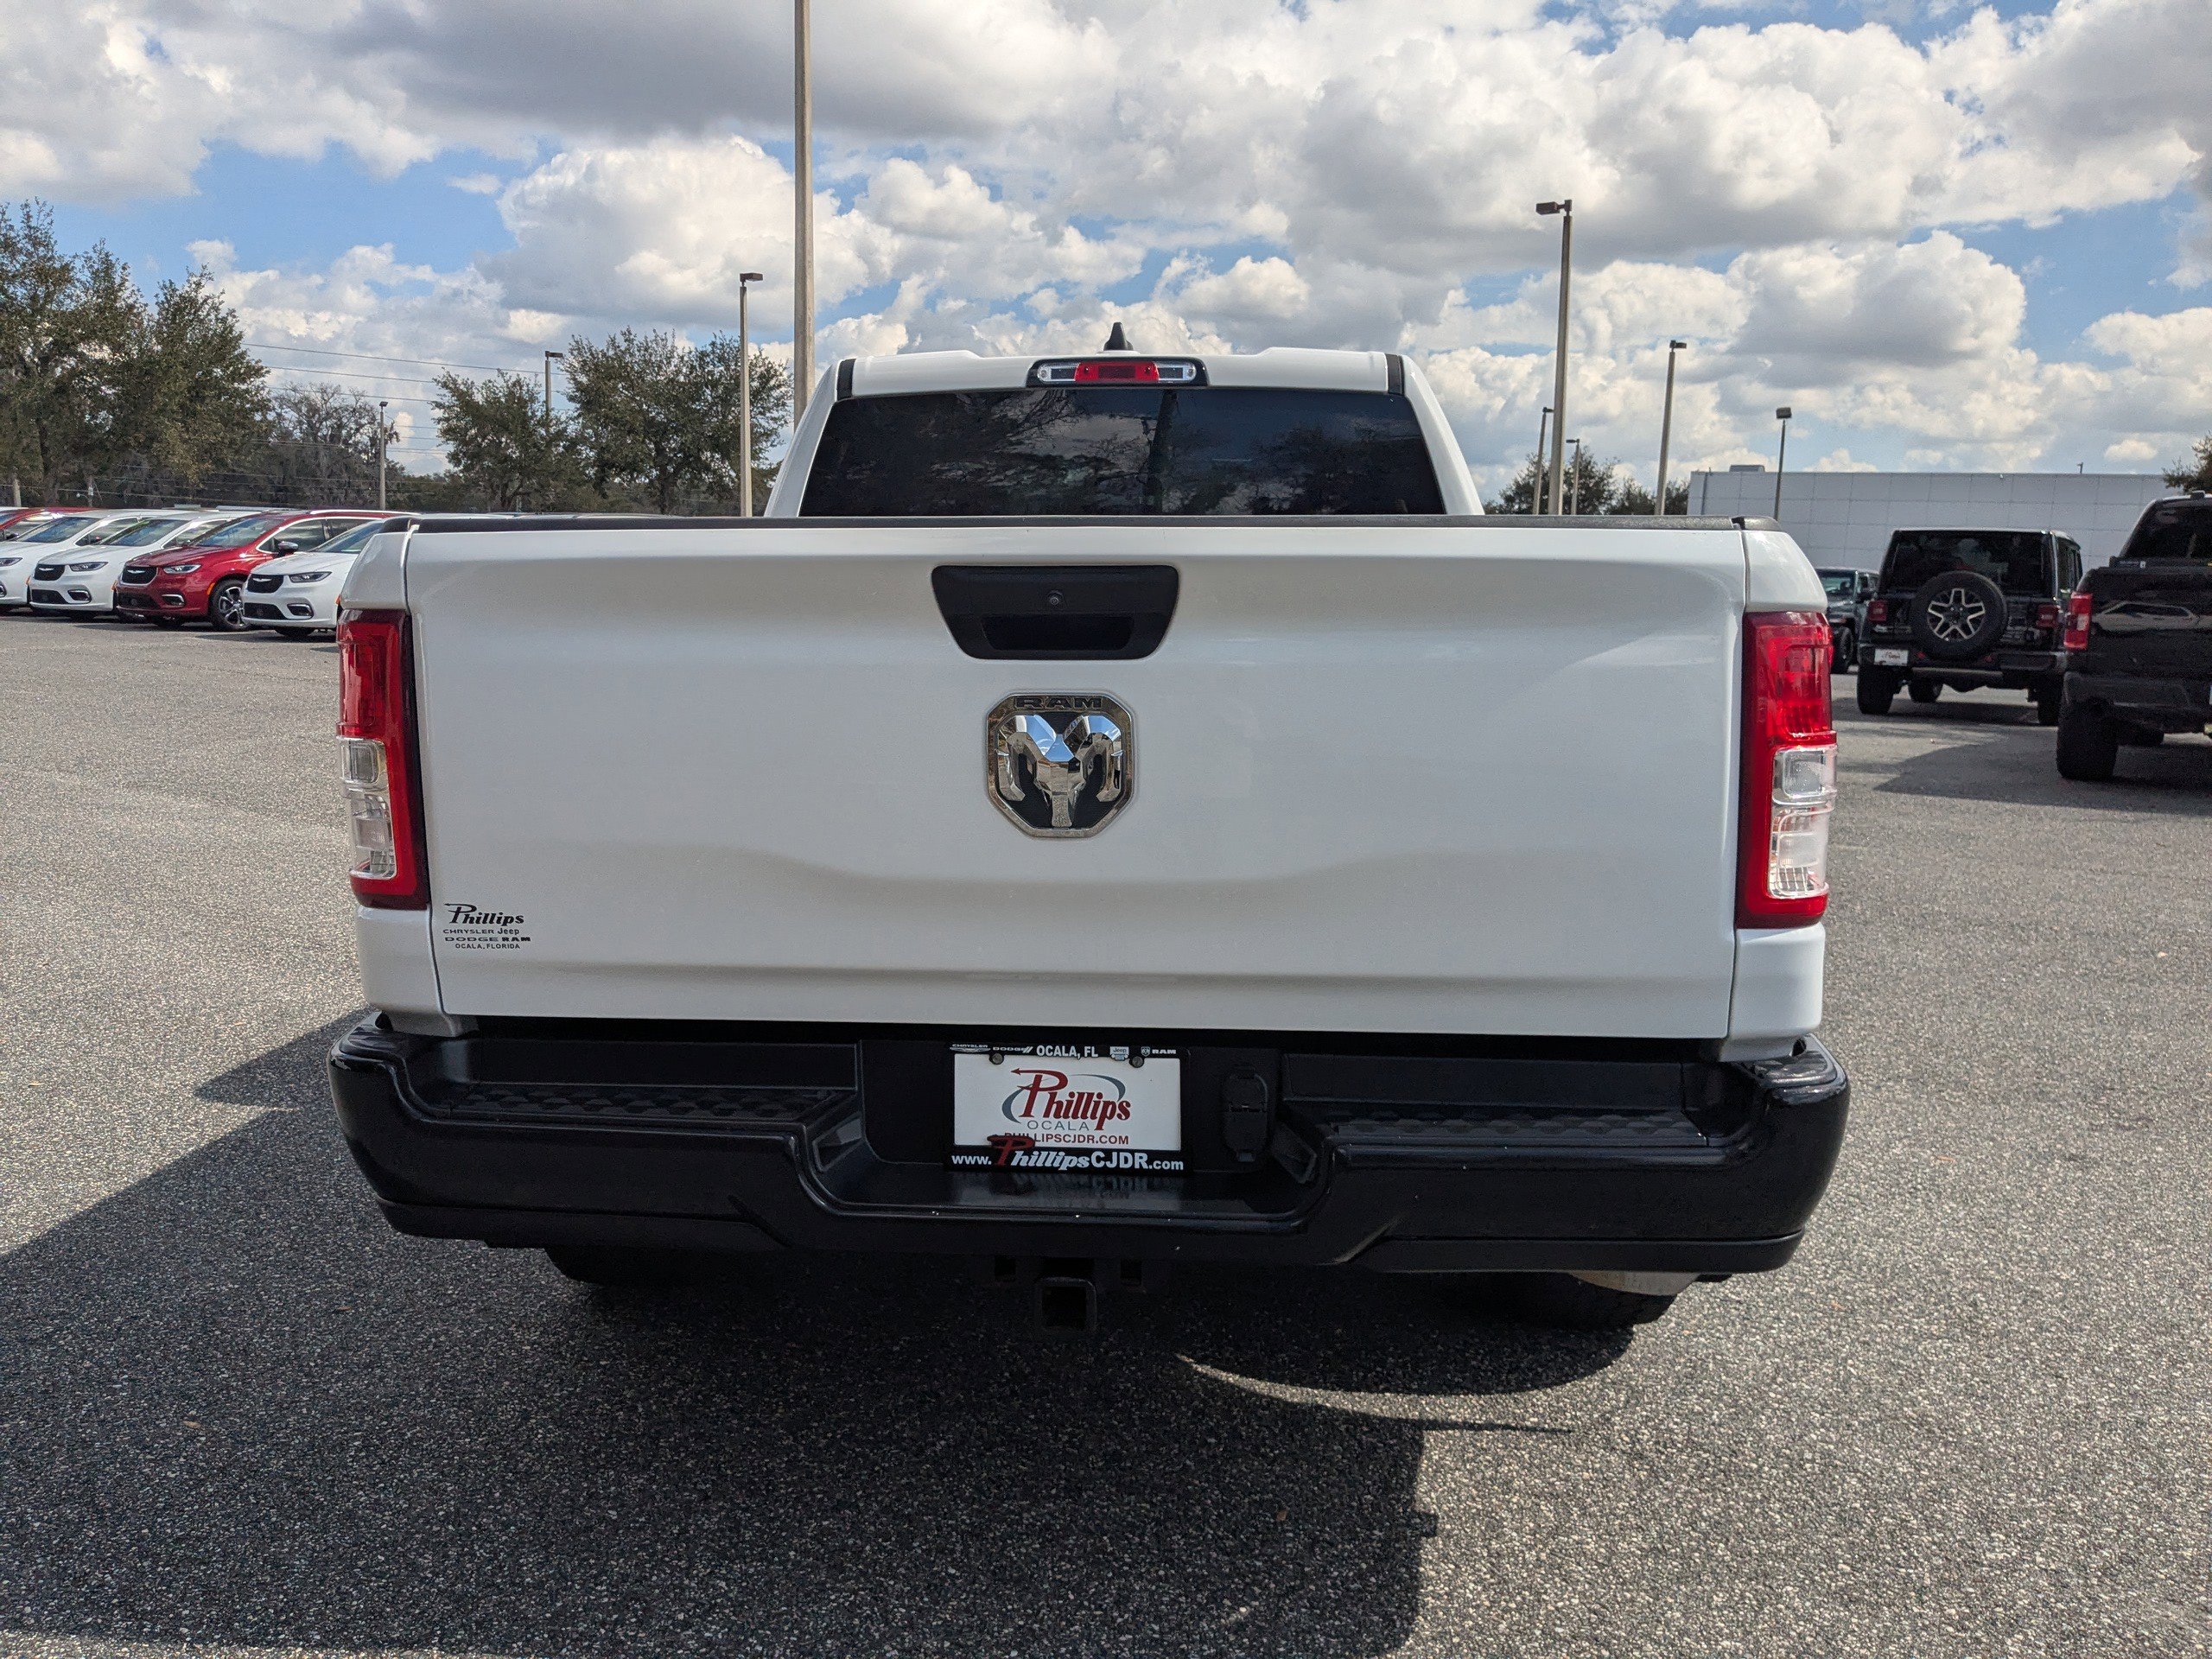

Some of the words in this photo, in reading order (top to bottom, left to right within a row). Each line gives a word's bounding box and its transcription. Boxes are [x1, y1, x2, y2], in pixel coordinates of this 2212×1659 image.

[1016, 696, 1102, 709] RAM
[444, 903, 524, 926] Phillips
[1037, 1045, 1081, 1059] OCALA,
[1084, 1046, 1099, 1058] FL
[1011, 1068, 1131, 1131] Phillips
[1027, 1120, 1090, 1131] OCALA
[1003, 1132, 1129, 1145] LIPSCJDR.COM
